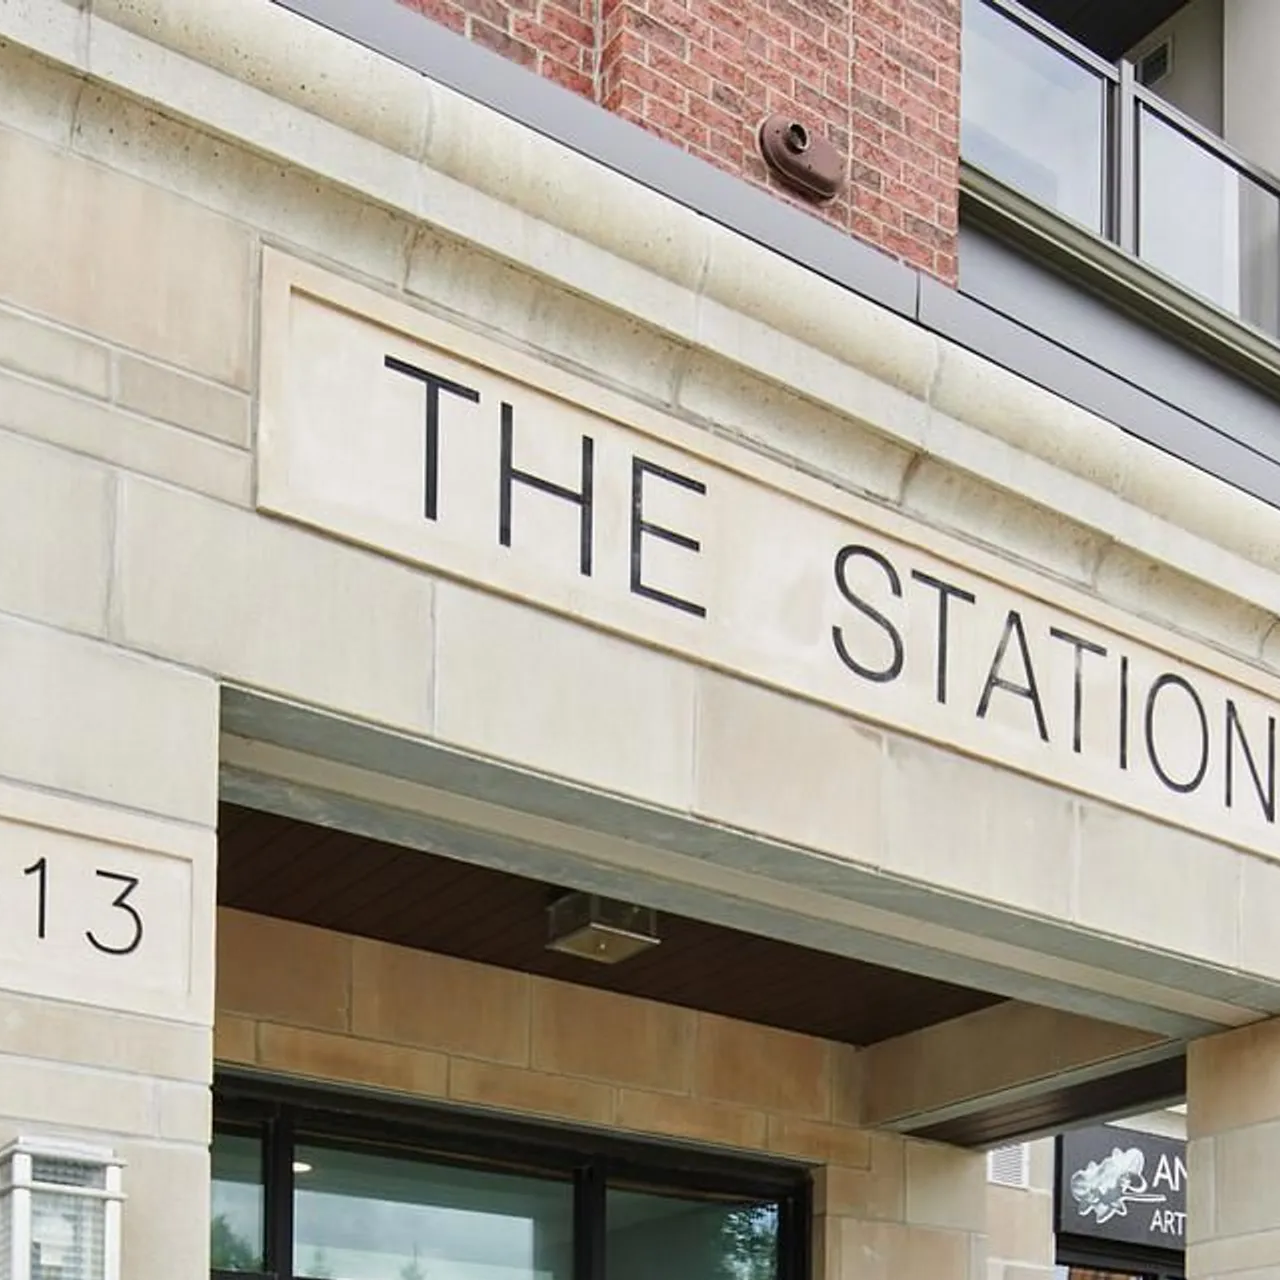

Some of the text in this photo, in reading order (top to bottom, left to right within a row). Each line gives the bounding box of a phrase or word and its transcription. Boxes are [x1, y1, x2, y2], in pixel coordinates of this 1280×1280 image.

[384, 354, 1277, 824] THE STATION
[1149, 1208, 1187, 1236] ART
